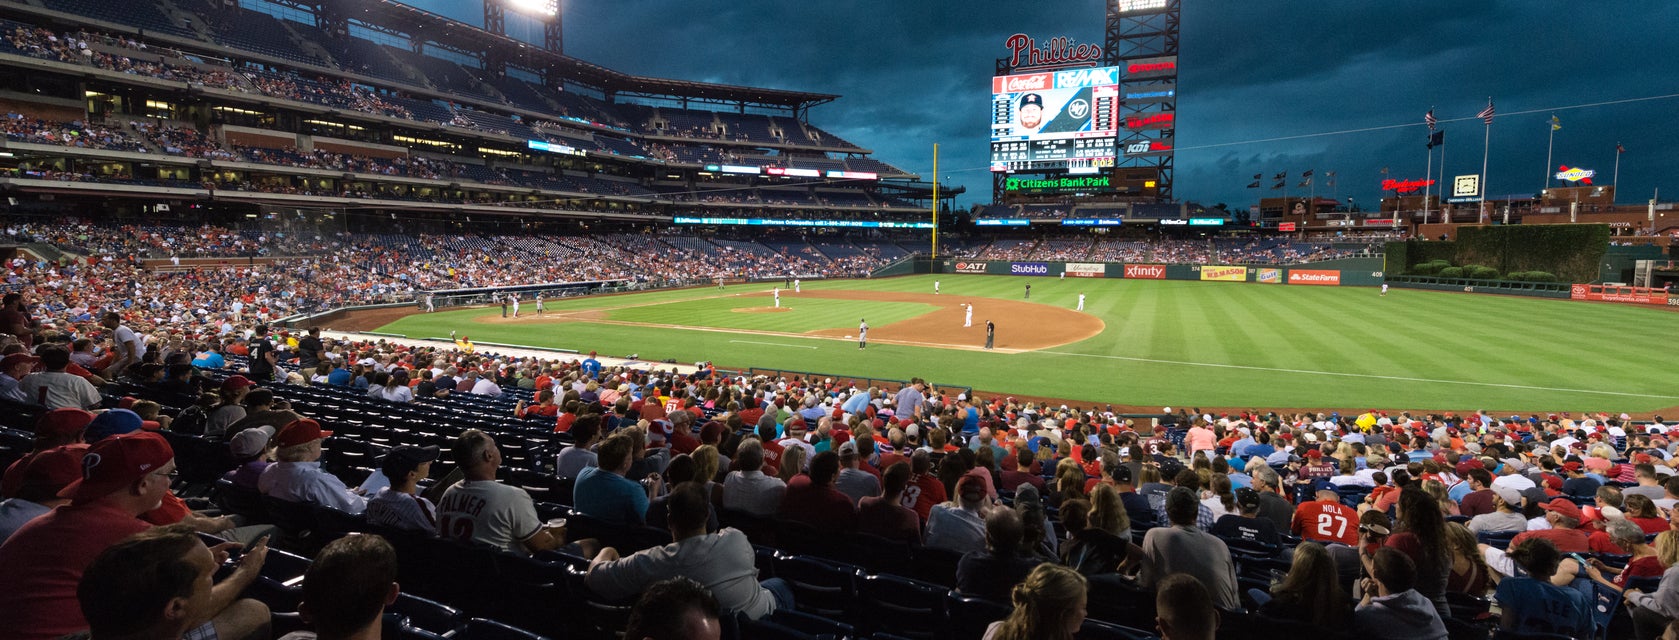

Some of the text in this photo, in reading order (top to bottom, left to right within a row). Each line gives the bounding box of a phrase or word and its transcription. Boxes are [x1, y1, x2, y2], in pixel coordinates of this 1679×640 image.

[1006, 33, 1102, 67] Phillies
[1140, 62, 1176, 71] TOYOTA
[1558, 170, 1594, 178] SUNOCO
[1020, 176, 1109, 188] Citizens Bank Park
[965, 262, 987, 270] ATI
[1011, 264, 1047, 273] StubHub
[1127, 265, 1163, 278] xfinity
[1260, 271, 1277, 280] Gulf
[1301, 273, 1338, 282] State Farm
[1322, 504, 1343, 515] NOLA
[1317, 513, 1348, 539] 27
